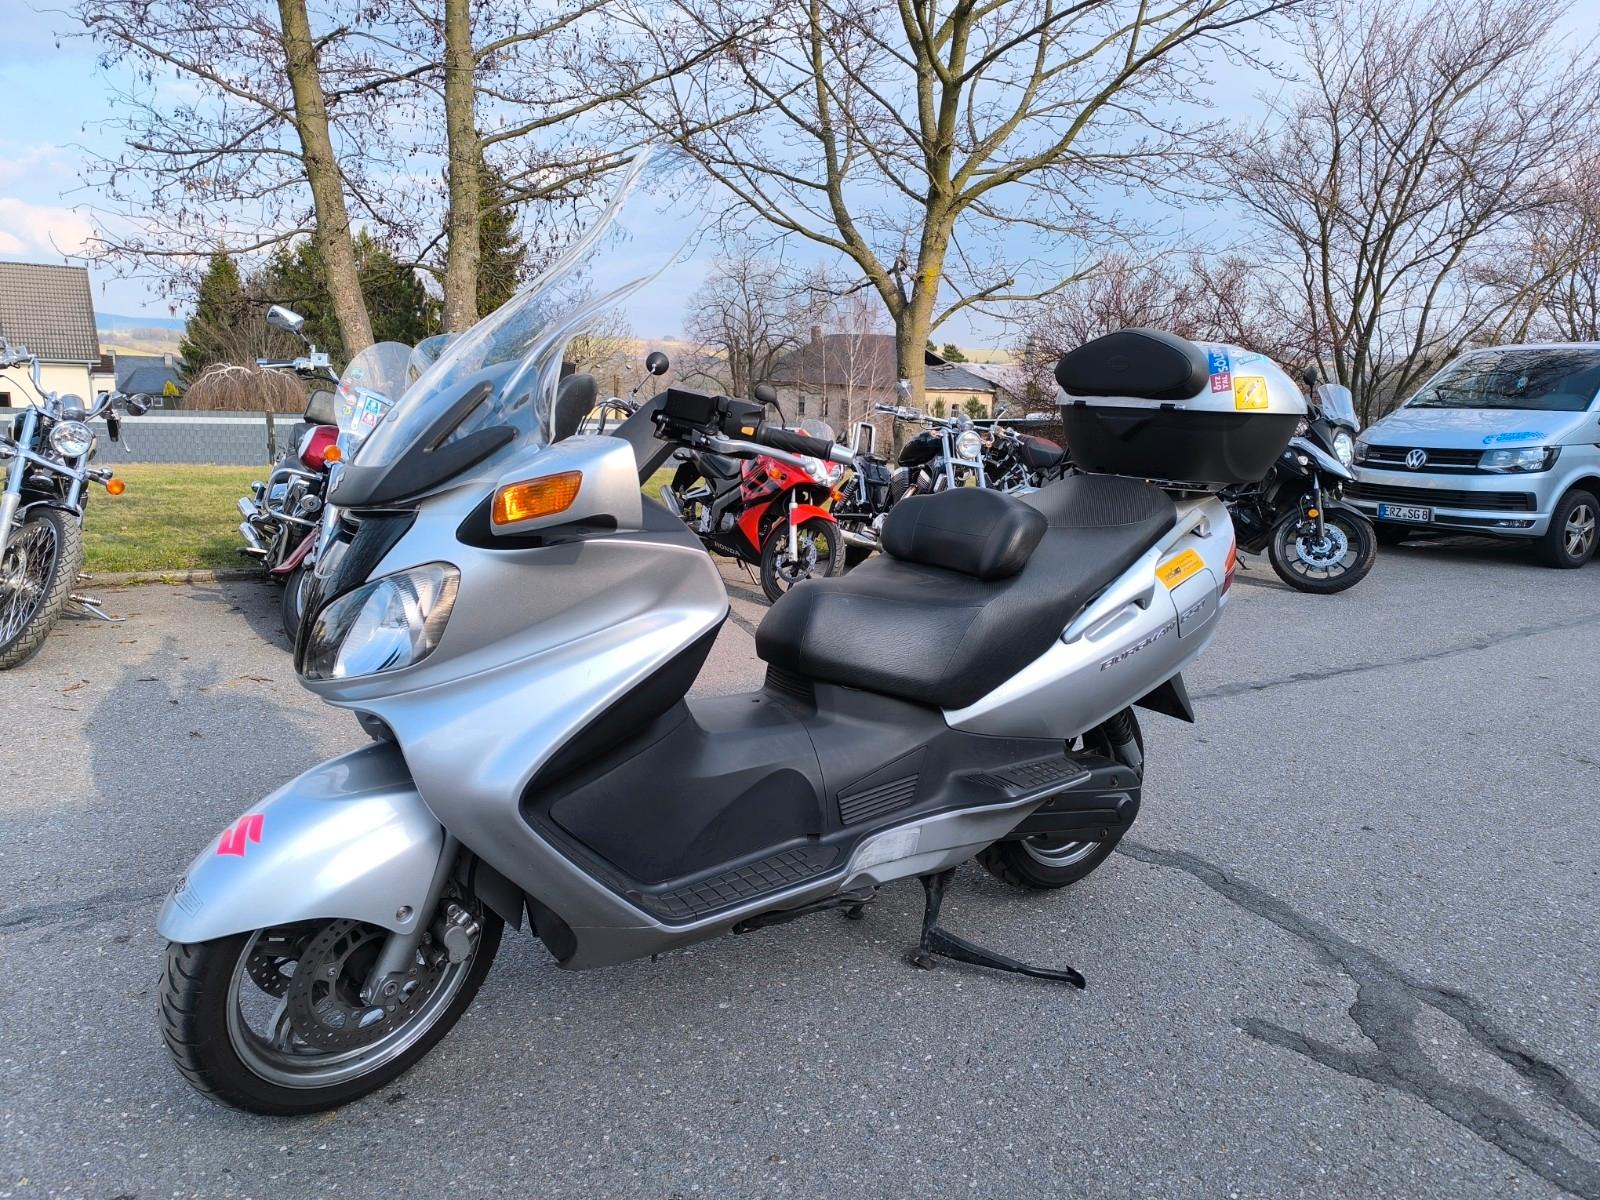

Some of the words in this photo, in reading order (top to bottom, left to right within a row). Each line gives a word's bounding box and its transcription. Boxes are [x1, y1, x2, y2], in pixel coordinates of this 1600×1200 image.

[1221, 375, 1230, 389] TAL
[1384, 506, 1402, 518] ERZ
[1407, 508, 1420, 519] SG
[1422, 510, 1428, 520] 8
[714, 541, 741, 557] HONDA
[1100, 620, 1176, 672] BURGMAN
